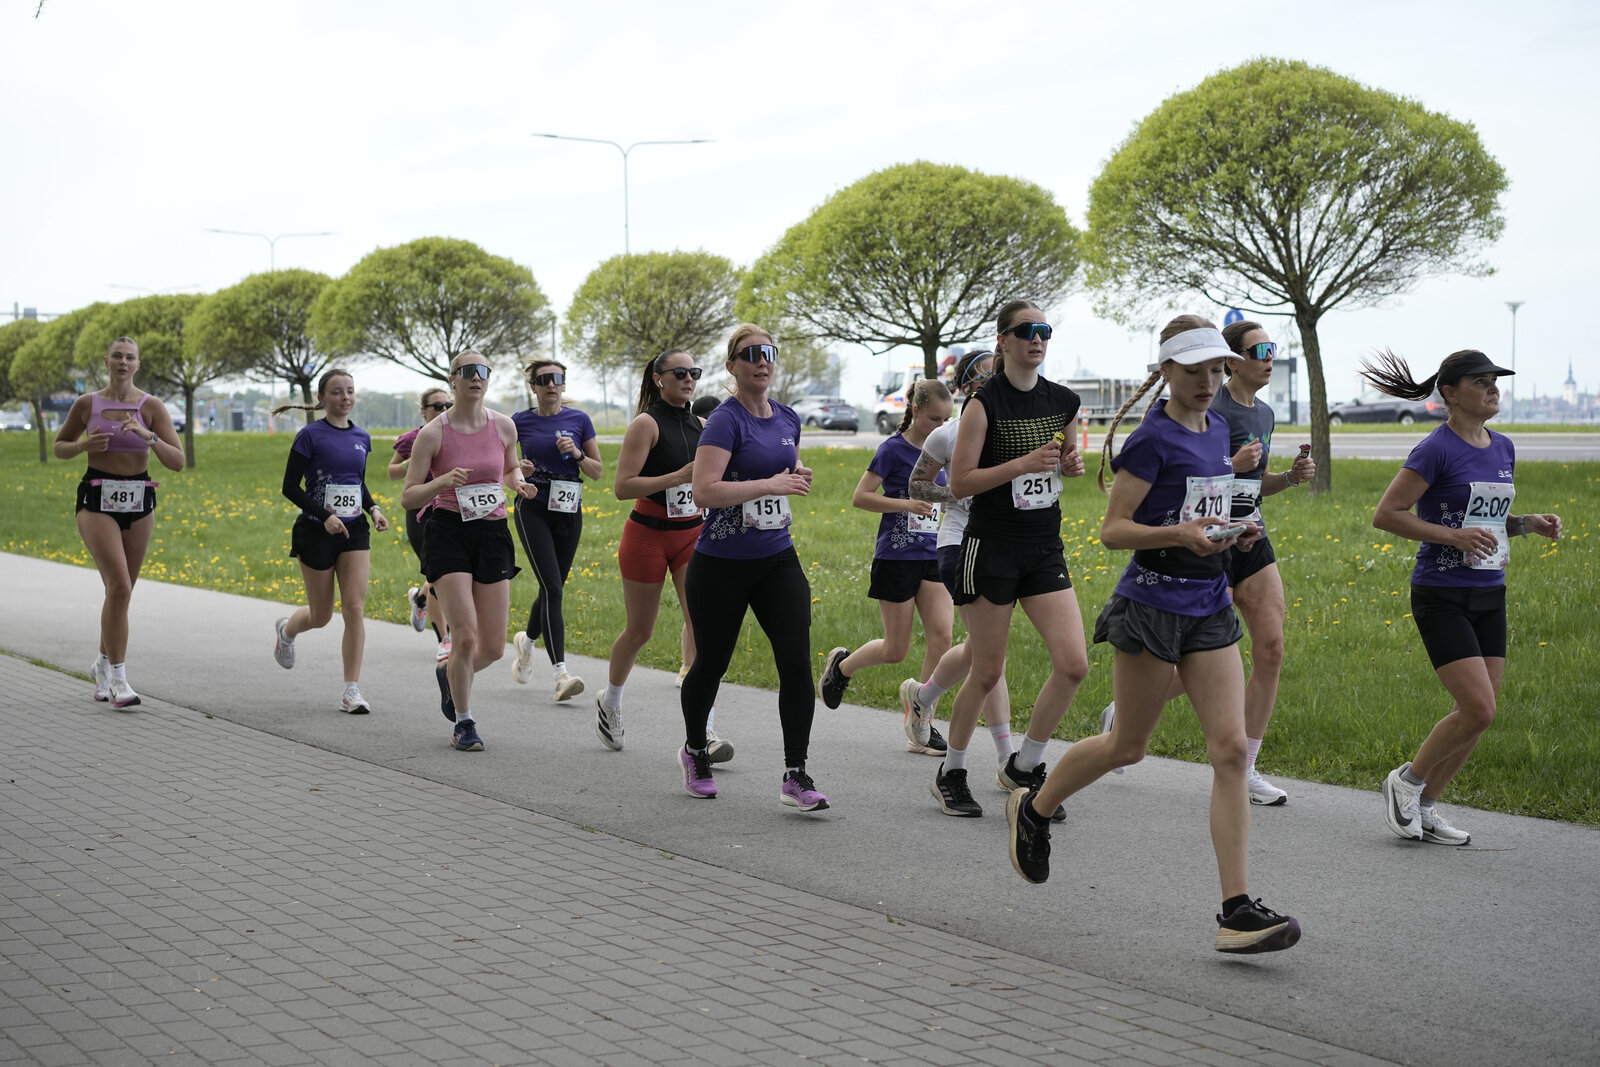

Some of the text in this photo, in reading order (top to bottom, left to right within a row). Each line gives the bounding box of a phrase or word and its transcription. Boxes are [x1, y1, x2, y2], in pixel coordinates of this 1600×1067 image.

[1023, 477, 1052, 495] 251
[110, 491, 135, 503] 481
[333, 495, 356, 507] 285
[469, 494, 497, 508] 150
[557, 490, 576, 503] 294
[676, 490, 693, 505] 29
[754, 499, 781, 515] 151
[1194, 495, 1222, 517] 470
[1469, 496, 1510, 517] 2:00
